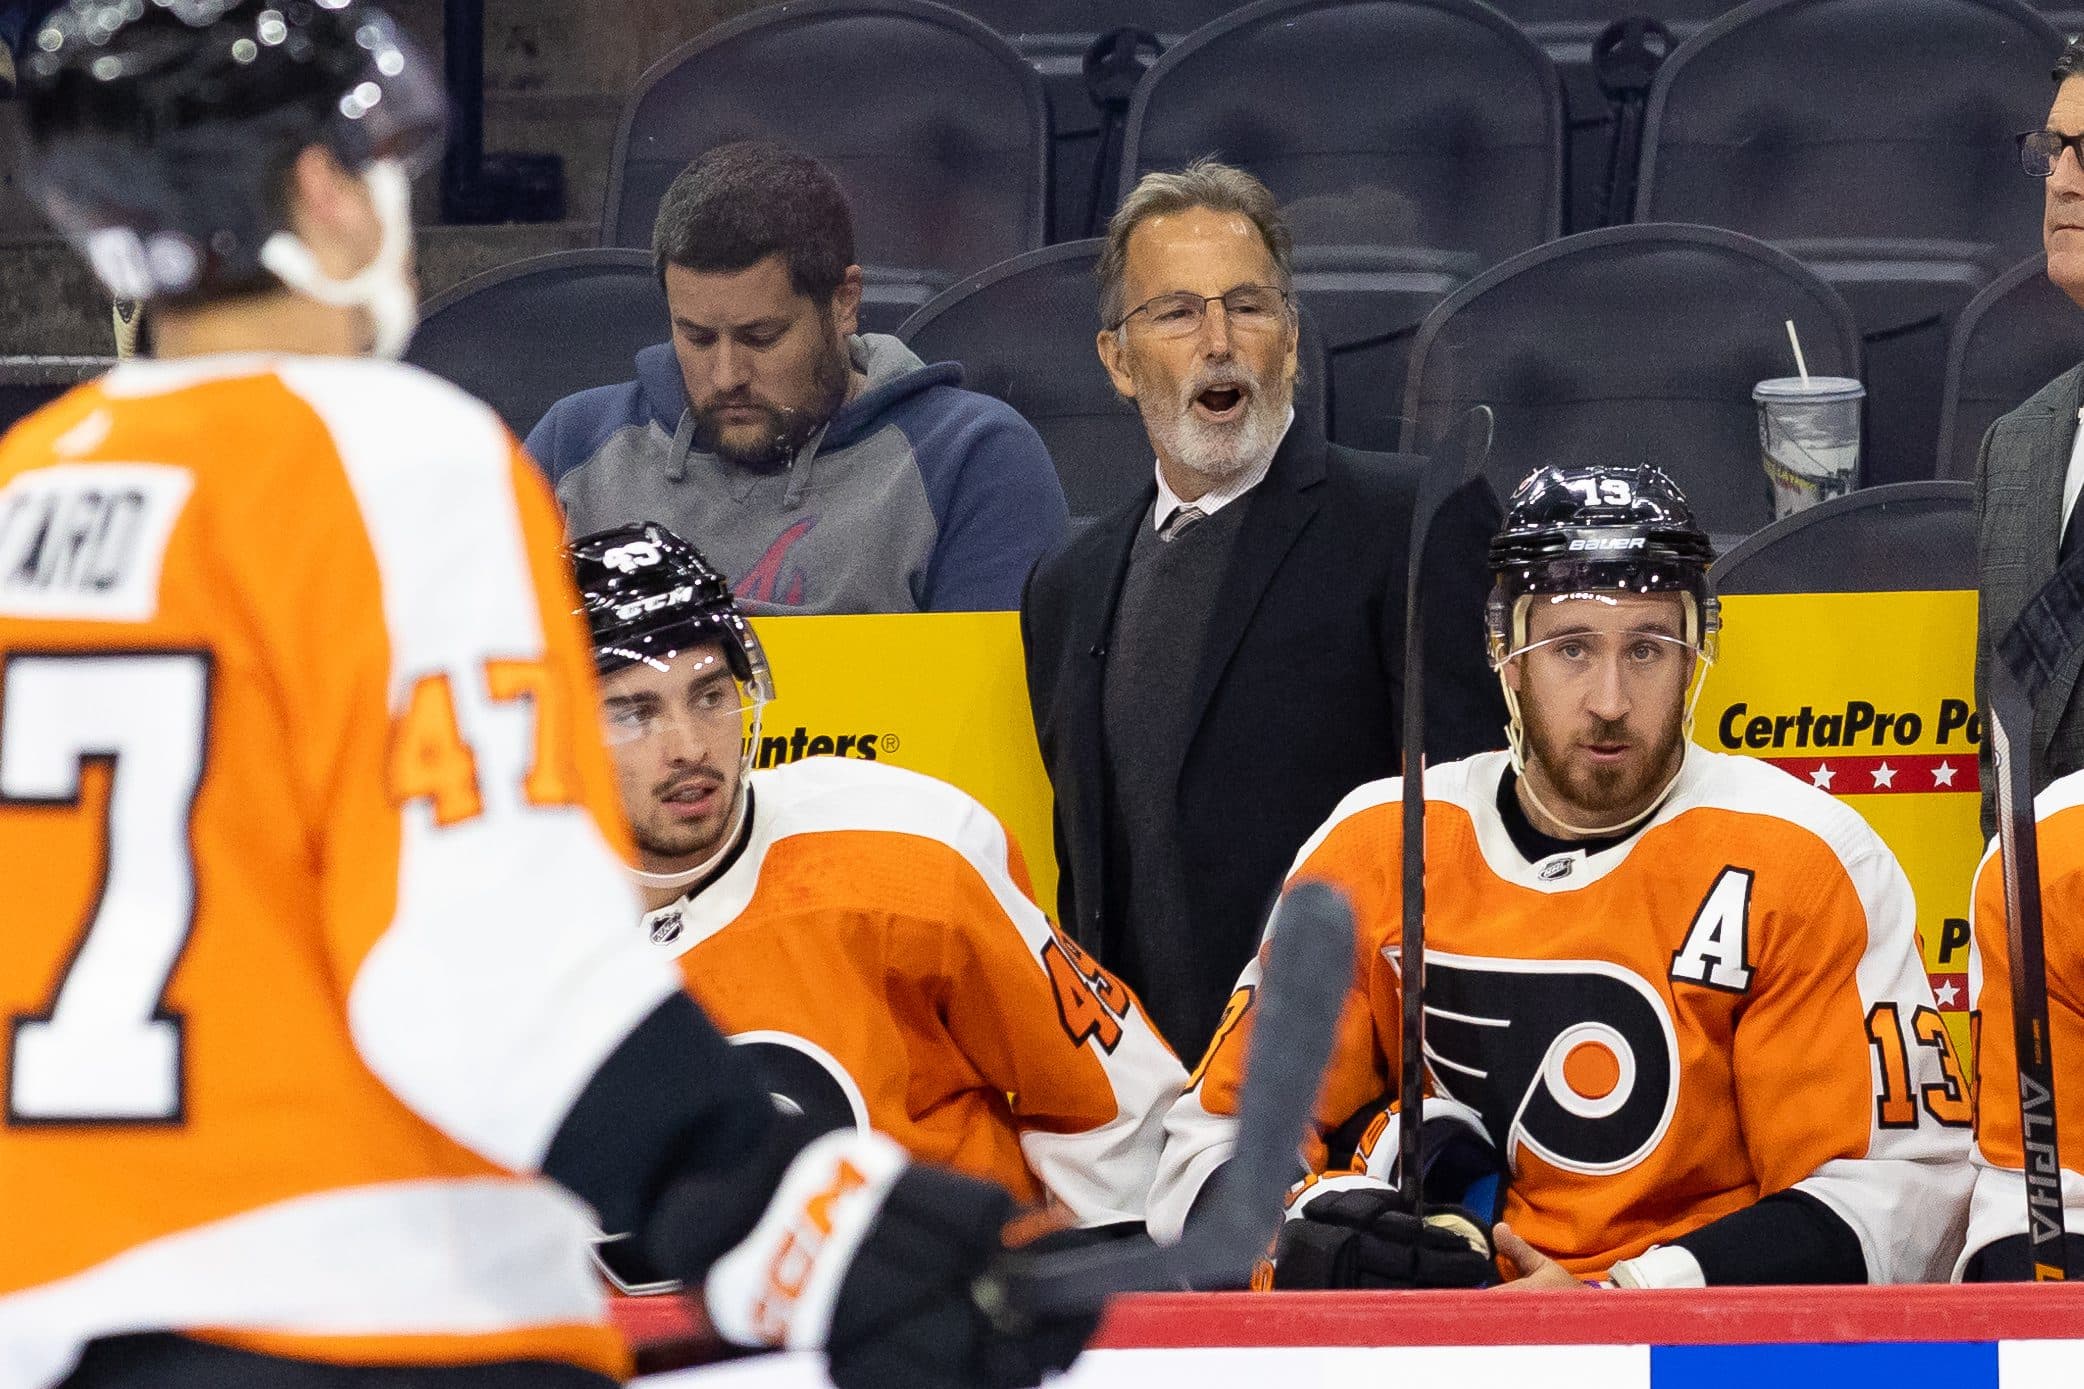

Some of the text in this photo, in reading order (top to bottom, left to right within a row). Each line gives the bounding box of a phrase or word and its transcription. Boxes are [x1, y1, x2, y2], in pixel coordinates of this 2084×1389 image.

[0, 488, 147, 594] ARD
[1568, 537, 1647, 551] BAUER
[1581, 478, 1632, 507] 13
[385, 660, 585, 830] 47
[1718, 700, 1922, 750] CertaPro
[1668, 864, 1756, 995] A
[1864, 1002, 1975, 1130] 13
[2020, 1070, 2063, 1246] ALPHA
